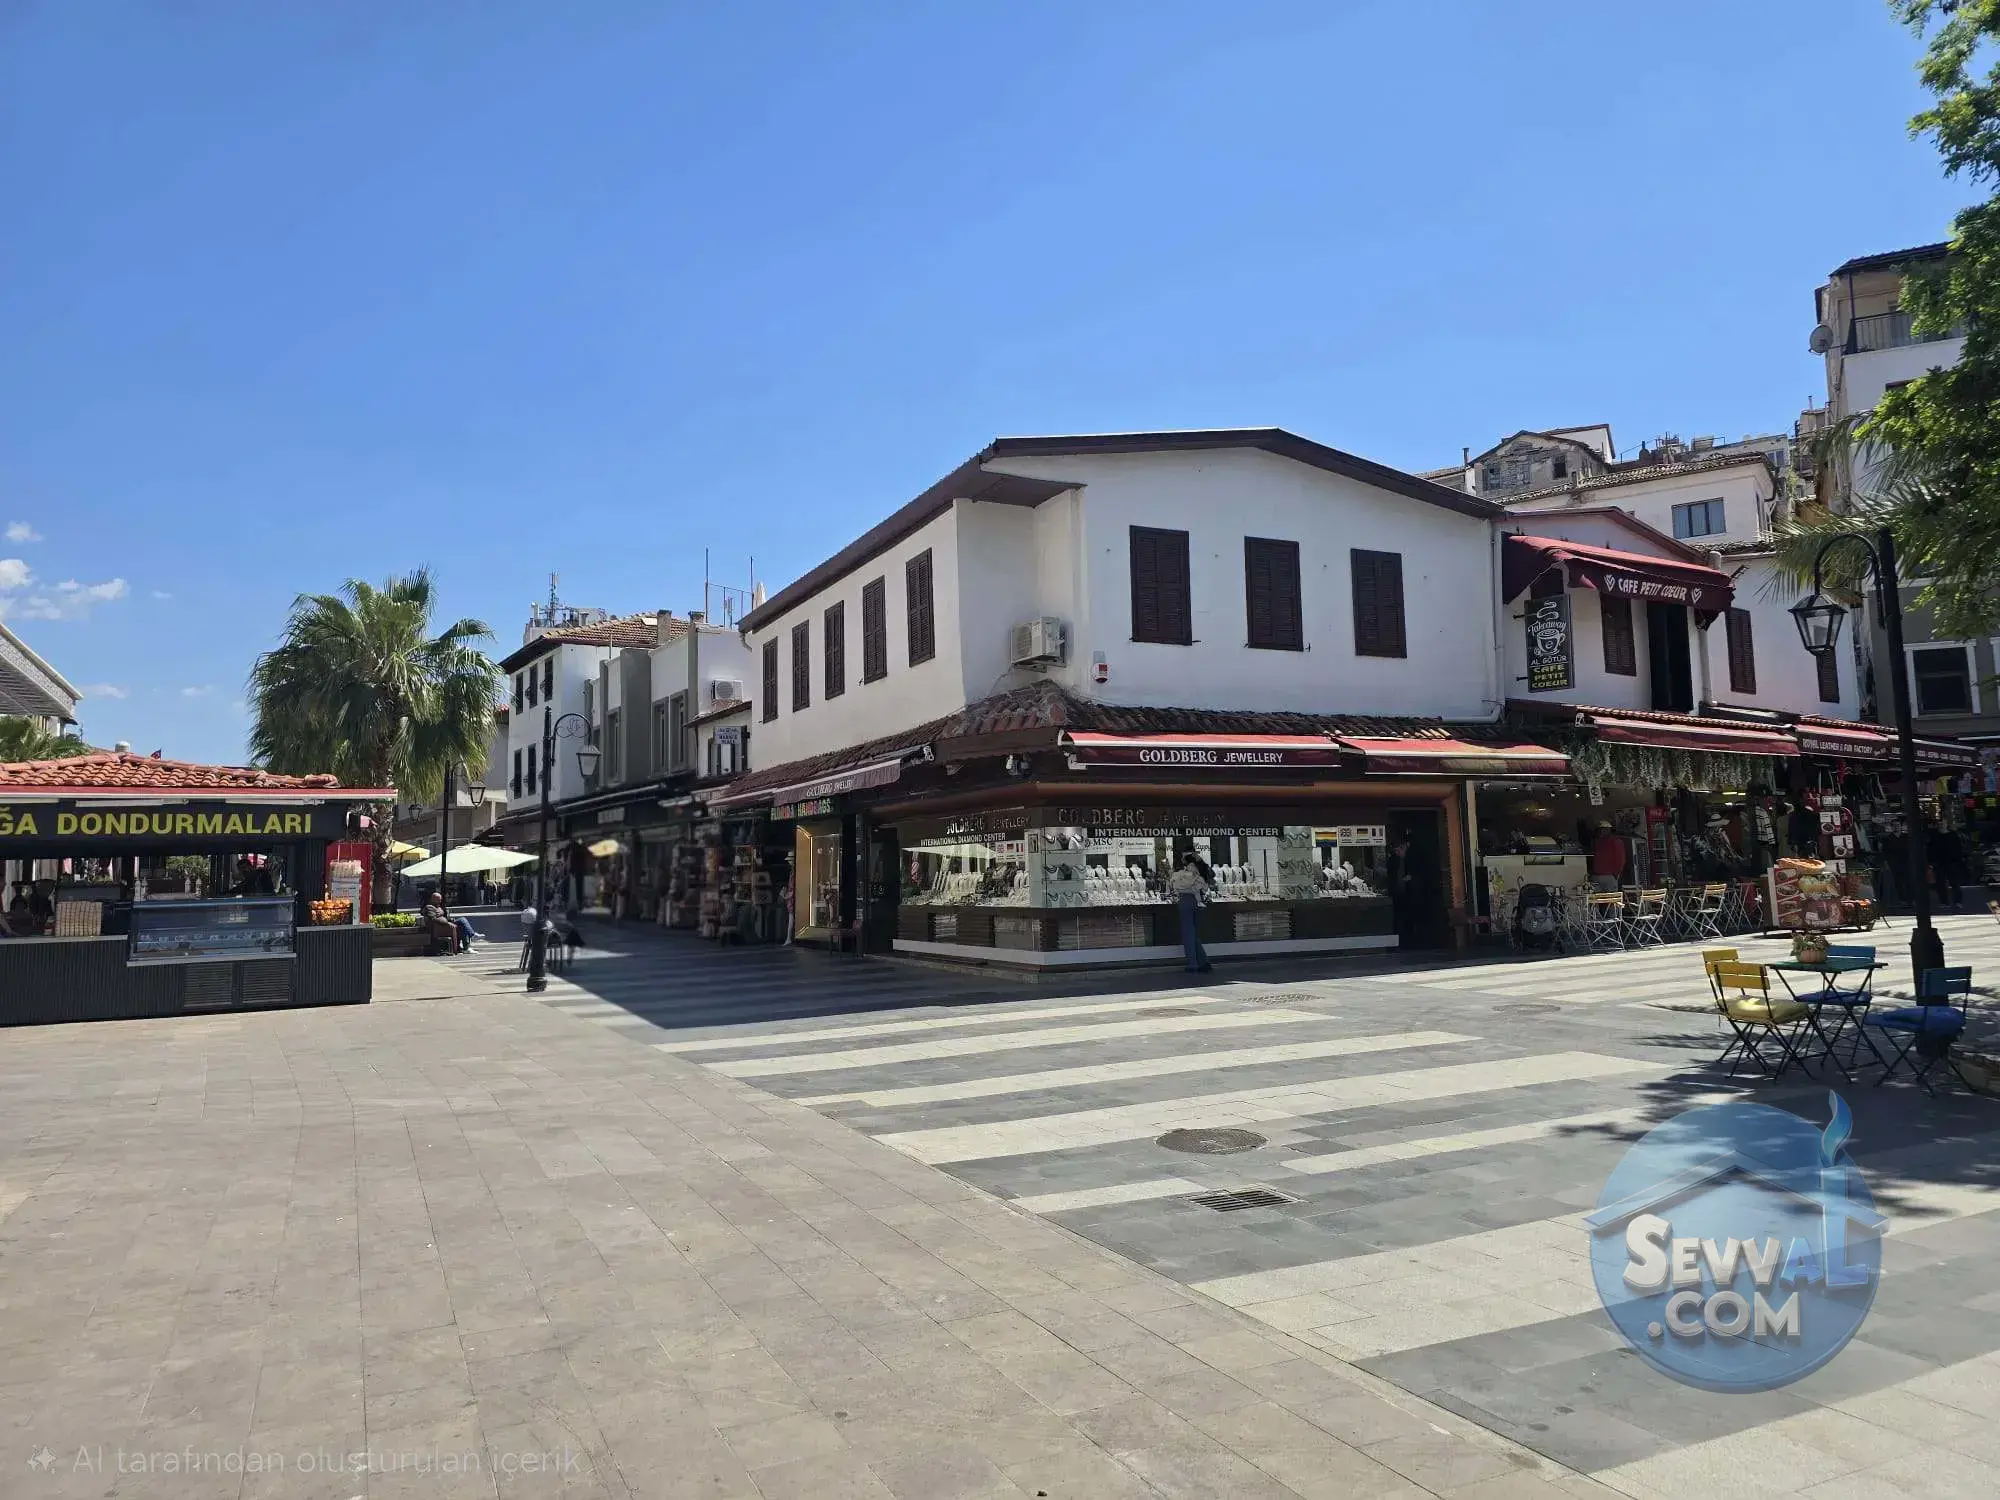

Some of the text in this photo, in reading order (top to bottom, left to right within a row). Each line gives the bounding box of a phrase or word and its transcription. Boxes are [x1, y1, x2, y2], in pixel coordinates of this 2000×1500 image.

[1618, 578, 1687, 601] CAFE PETIT COEUR
[1527, 620, 1567, 638] Takeaway
[1533, 663, 1566, 674] CAFE
[1534, 672, 1565, 682] PETIT
[1531, 679, 1568, 689] COEUR
[1139, 749, 1283, 763] GOLDBERG JEWELLERY
[56, 813, 311, 835] DONDURMALARI
[983, 832, 1006, 841] CENTER
[1094, 828, 1279, 837] INTERNATIONAL DIAMOND CENTER
[1093, 837, 1113, 846] MSC
